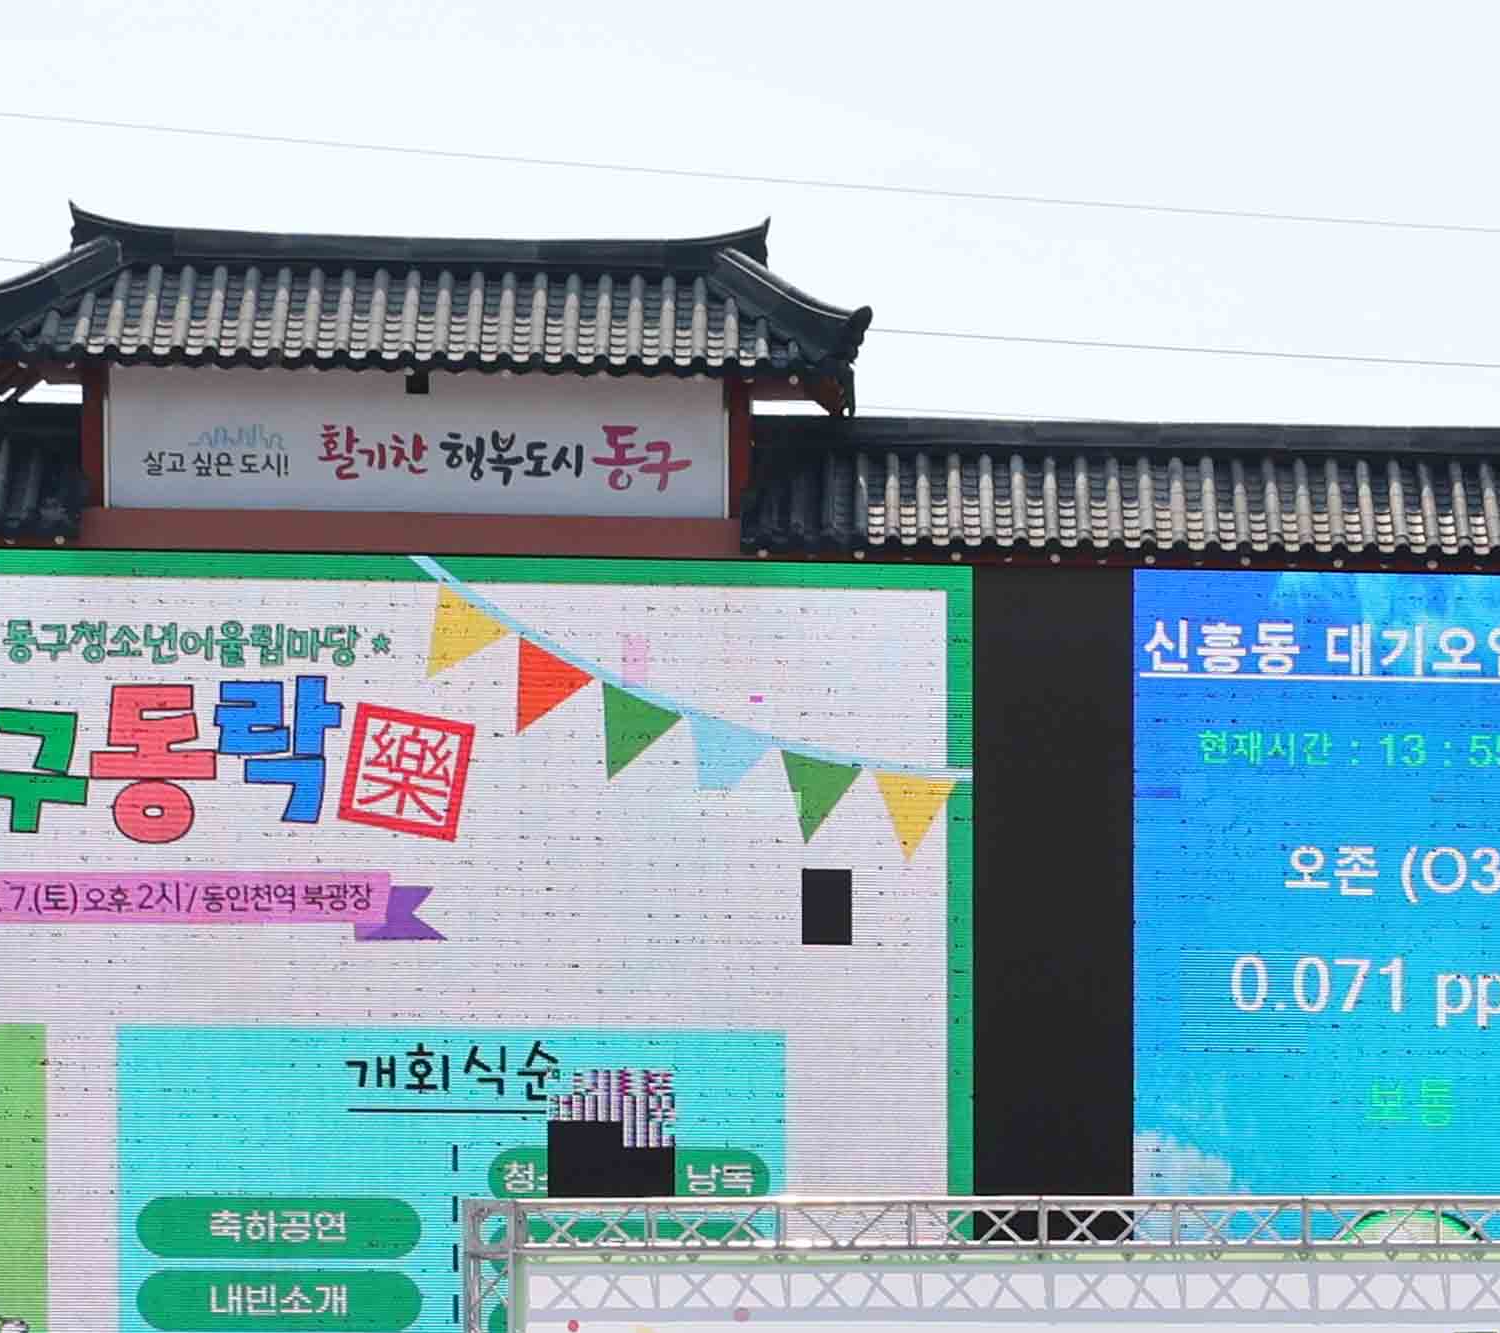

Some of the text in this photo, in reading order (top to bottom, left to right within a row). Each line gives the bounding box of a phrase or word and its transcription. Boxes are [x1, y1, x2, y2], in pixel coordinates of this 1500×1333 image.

[143, 424, 692, 492] 살고 싶은 도시! 활기찬 행복도시 동구
[3, 620, 359, 667] 동구청소년어울림마당
[1143, 620, 1301, 675] 신흥동
[1198, 731, 1333, 767] 현재시간
[1380, 733, 1426, 768] 13
[1285, 845, 1380, 898] 오존
[84, 886, 132, 914] 오후
[203, 883, 297, 914] 동인천역
[302, 883, 373, 913] 북광장
[1231, 955, 1405, 1014] 0.071
[209, 1209, 348, 1244] 축하공연
[209, 1283, 349, 1318] 내빈소개
